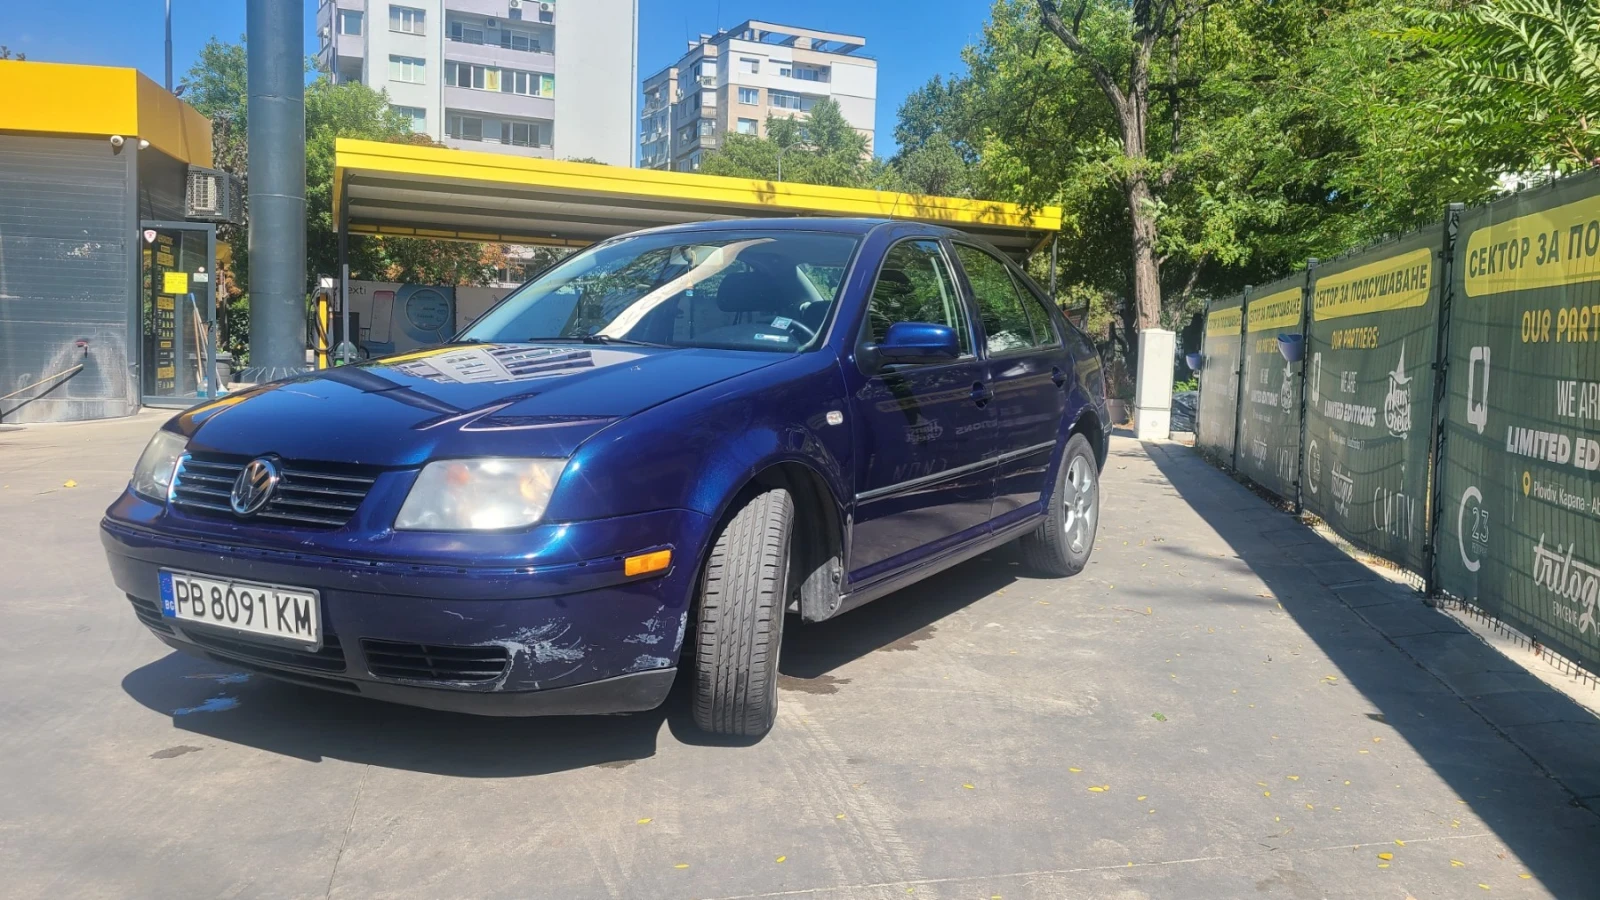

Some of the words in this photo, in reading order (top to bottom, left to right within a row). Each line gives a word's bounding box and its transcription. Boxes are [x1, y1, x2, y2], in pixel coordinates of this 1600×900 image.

[1469, 236, 1531, 279] СЕКТОР
[1536, 230, 1559, 266] ЗА
[1340, 283, 1349, 304] ЗА
[1350, 264, 1428, 304] ПОДСУШАВАНЕ
[1521, 308, 1551, 344] OUR
[1343, 403, 1377, 428] EDITIONS
[1557, 379, 1577, 418] WE
[1506, 425, 1571, 465] LIMITED
[1559, 488, 1585, 510] Kapana
[164, 599, 175, 611] BG
[175, 579, 205, 616] PB
[211, 586, 269, 629] 8091
[275, 593, 313, 637] KM
